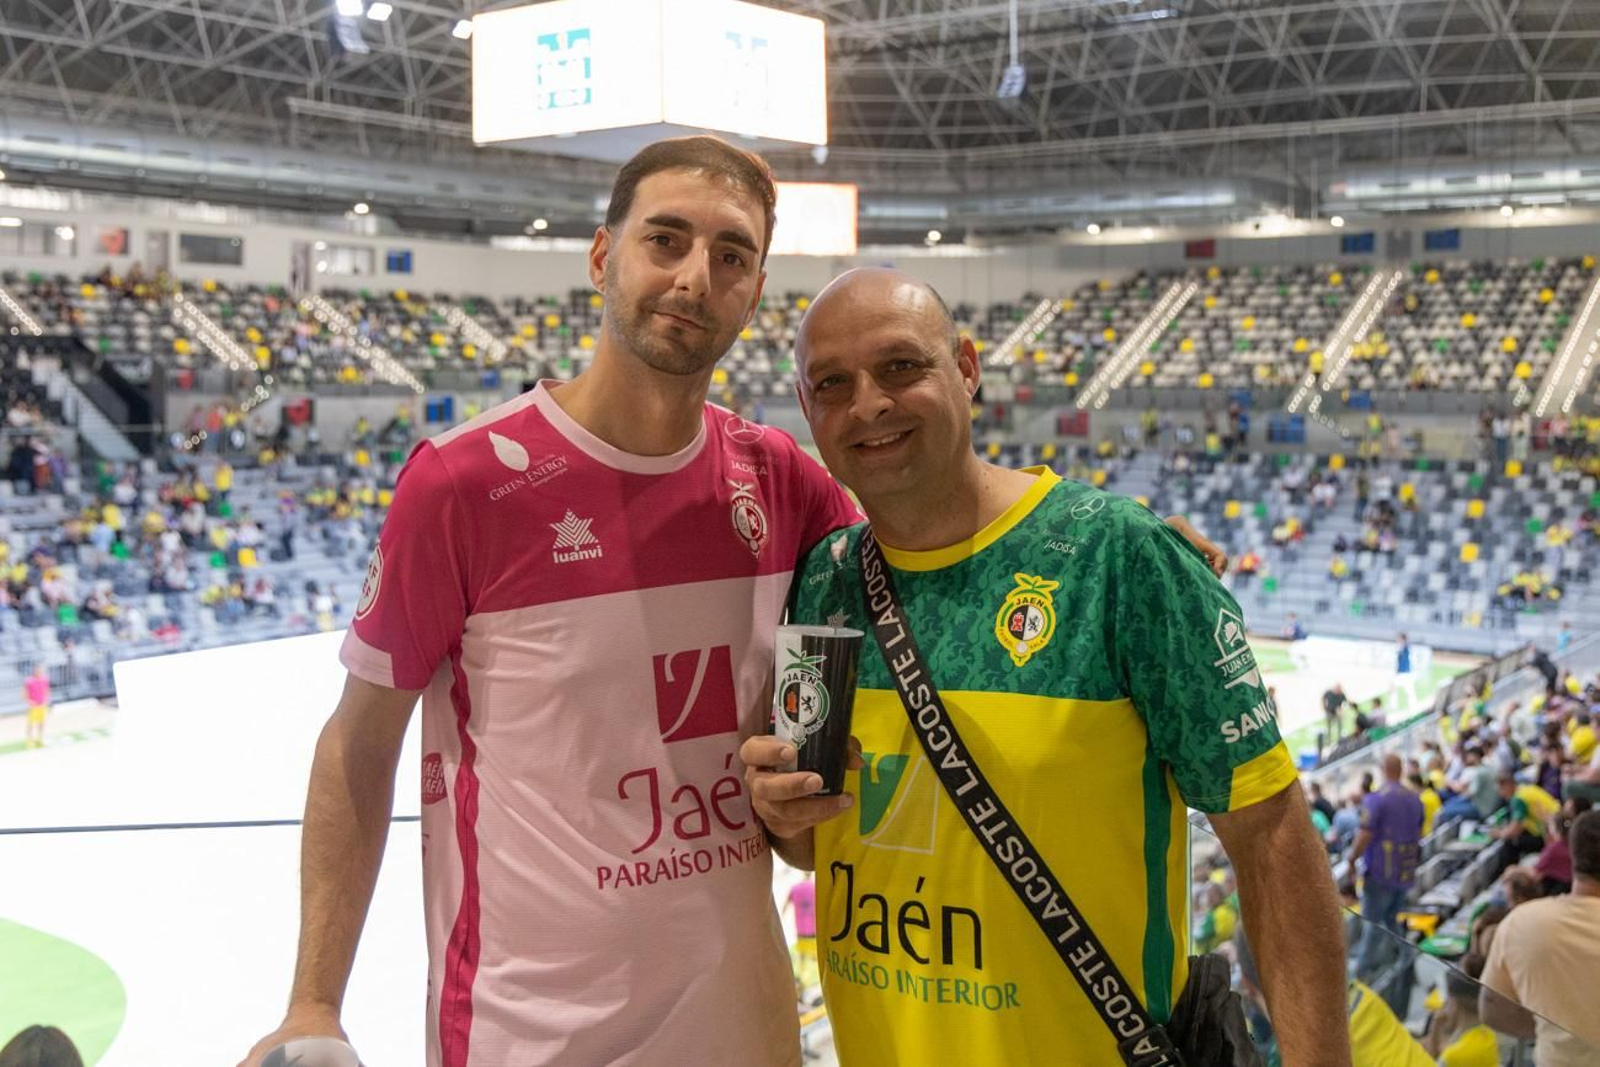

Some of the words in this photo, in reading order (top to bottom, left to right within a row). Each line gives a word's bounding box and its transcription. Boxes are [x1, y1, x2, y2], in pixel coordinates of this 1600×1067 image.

[489, 475, 527, 501] GREEN
[525, 455, 568, 482] ENERGY
[552, 545, 603, 563] luanvi
[862, 534, 906, 649] LACOSTE
[1015, 597, 1044, 608] JAEN
[786, 673, 817, 686] JAEN
[892, 648, 979, 797] LACOSTE
[596, 848, 713, 890] PARAÍSO
[967, 797, 1081, 944] LACOSTE
[830, 860, 983, 971] Jaén
[896, 969, 1022, 1012] INTERIOR
